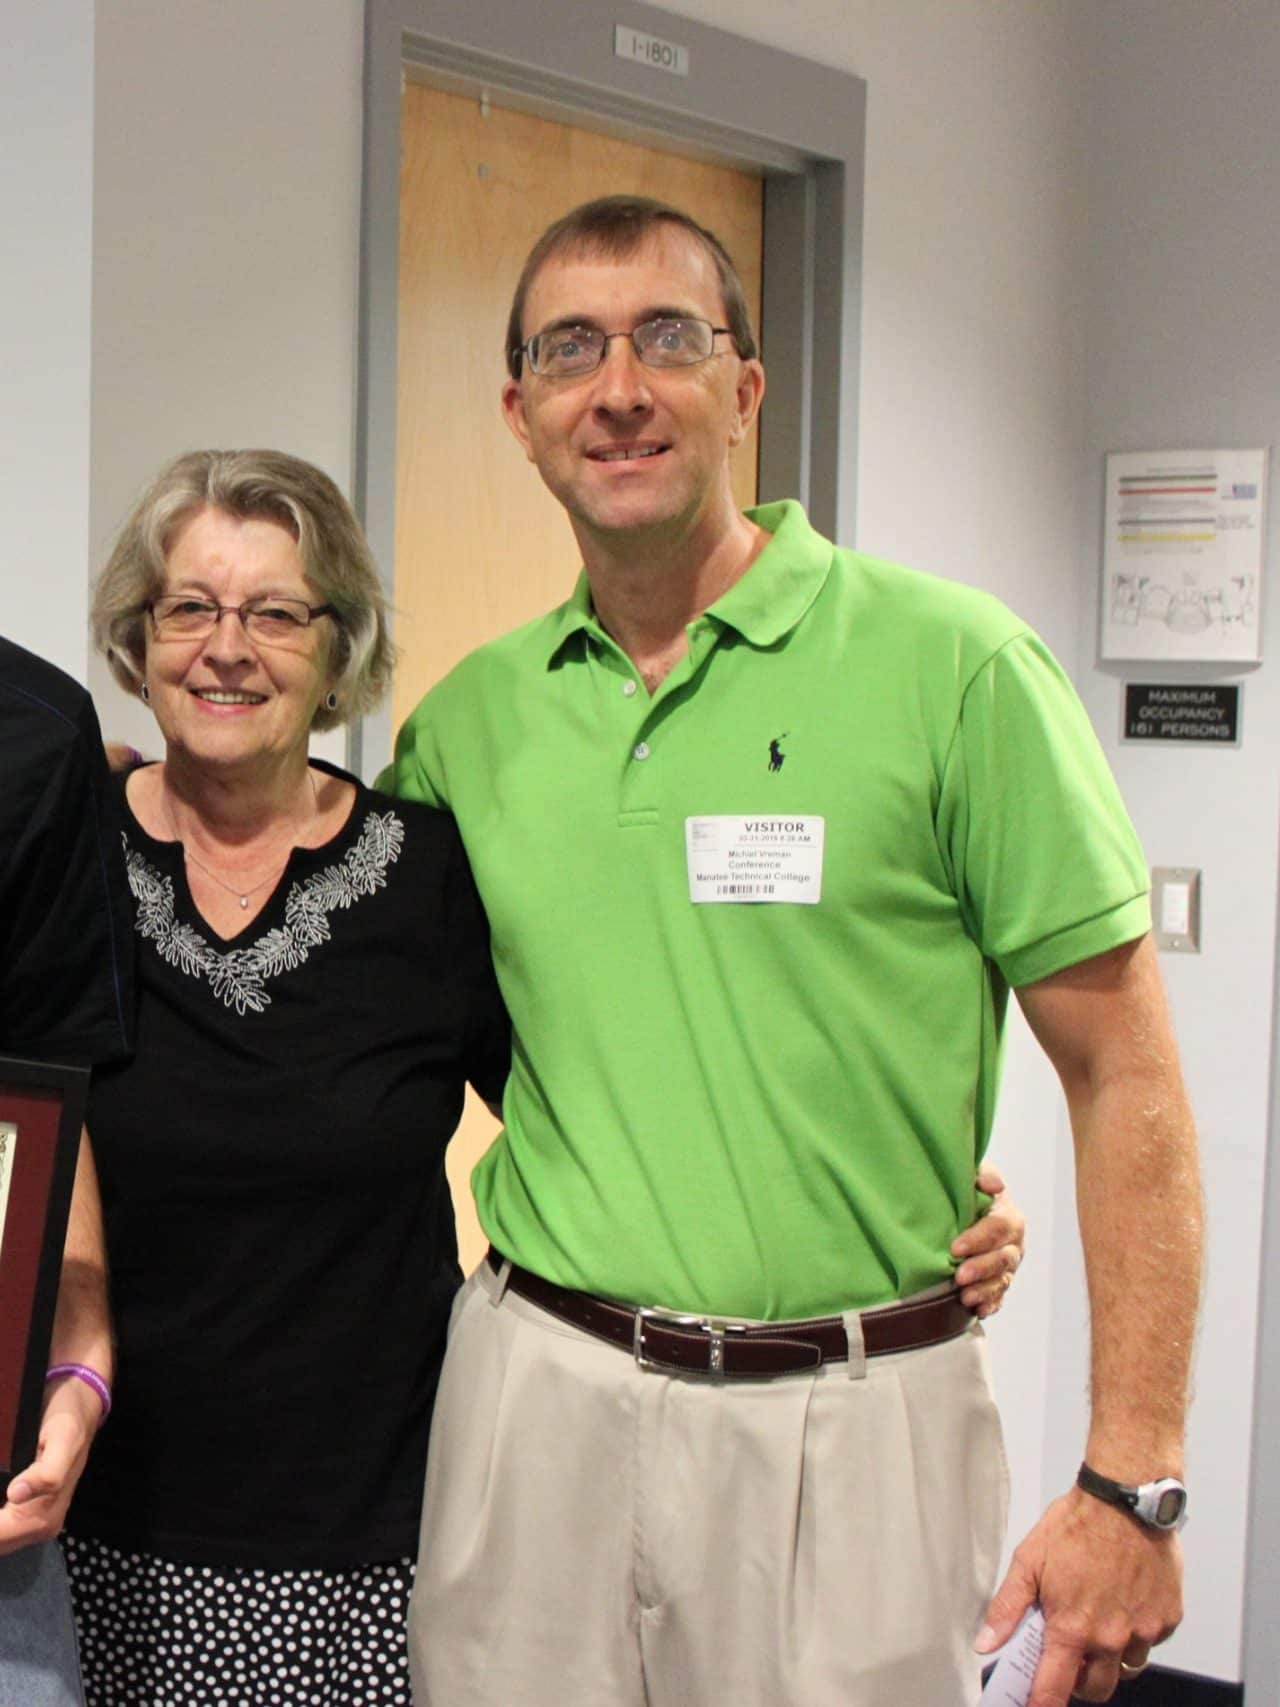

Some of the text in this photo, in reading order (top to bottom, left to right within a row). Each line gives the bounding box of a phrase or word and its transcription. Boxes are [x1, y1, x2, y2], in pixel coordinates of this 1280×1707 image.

[631, 35, 679, 69] 1-1801
[1148, 690, 1217, 704] MAXIMUM
[1138, 705, 1226, 721] OCCUPANCY
[1160, 722, 1231, 737] PERSONS
[744, 822, 805, 833] VISITOR
[728, 860, 781, 869] Conference
[696, 872, 810, 883] Manatee Technical College
